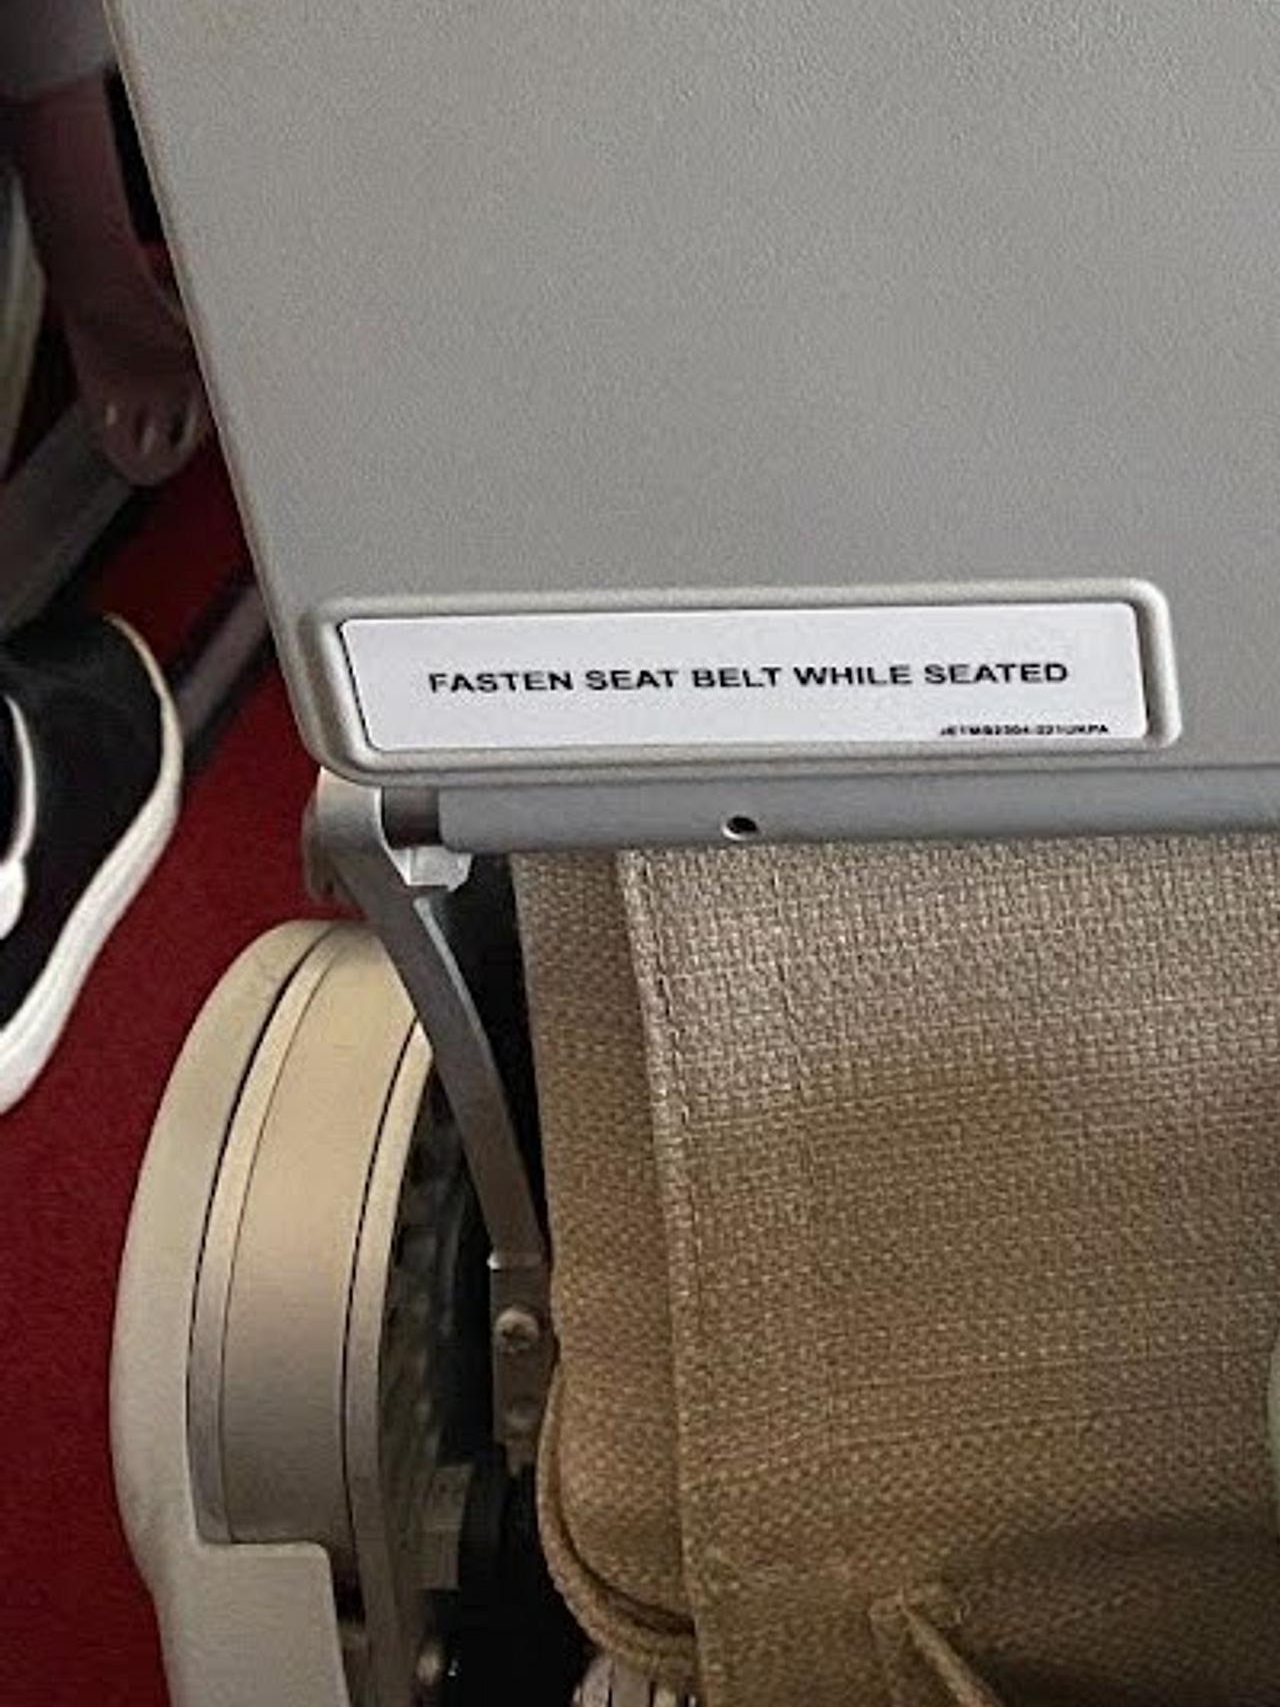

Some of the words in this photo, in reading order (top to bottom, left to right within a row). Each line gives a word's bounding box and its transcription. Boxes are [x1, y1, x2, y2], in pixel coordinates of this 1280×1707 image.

[429, 671, 573, 693] FASTEN
[585, 669, 679, 691] SEAT
[691, 665, 783, 688] BELT
[793, 665, 913, 687] WHILE
[924, 663, 1068, 685] SEATED
